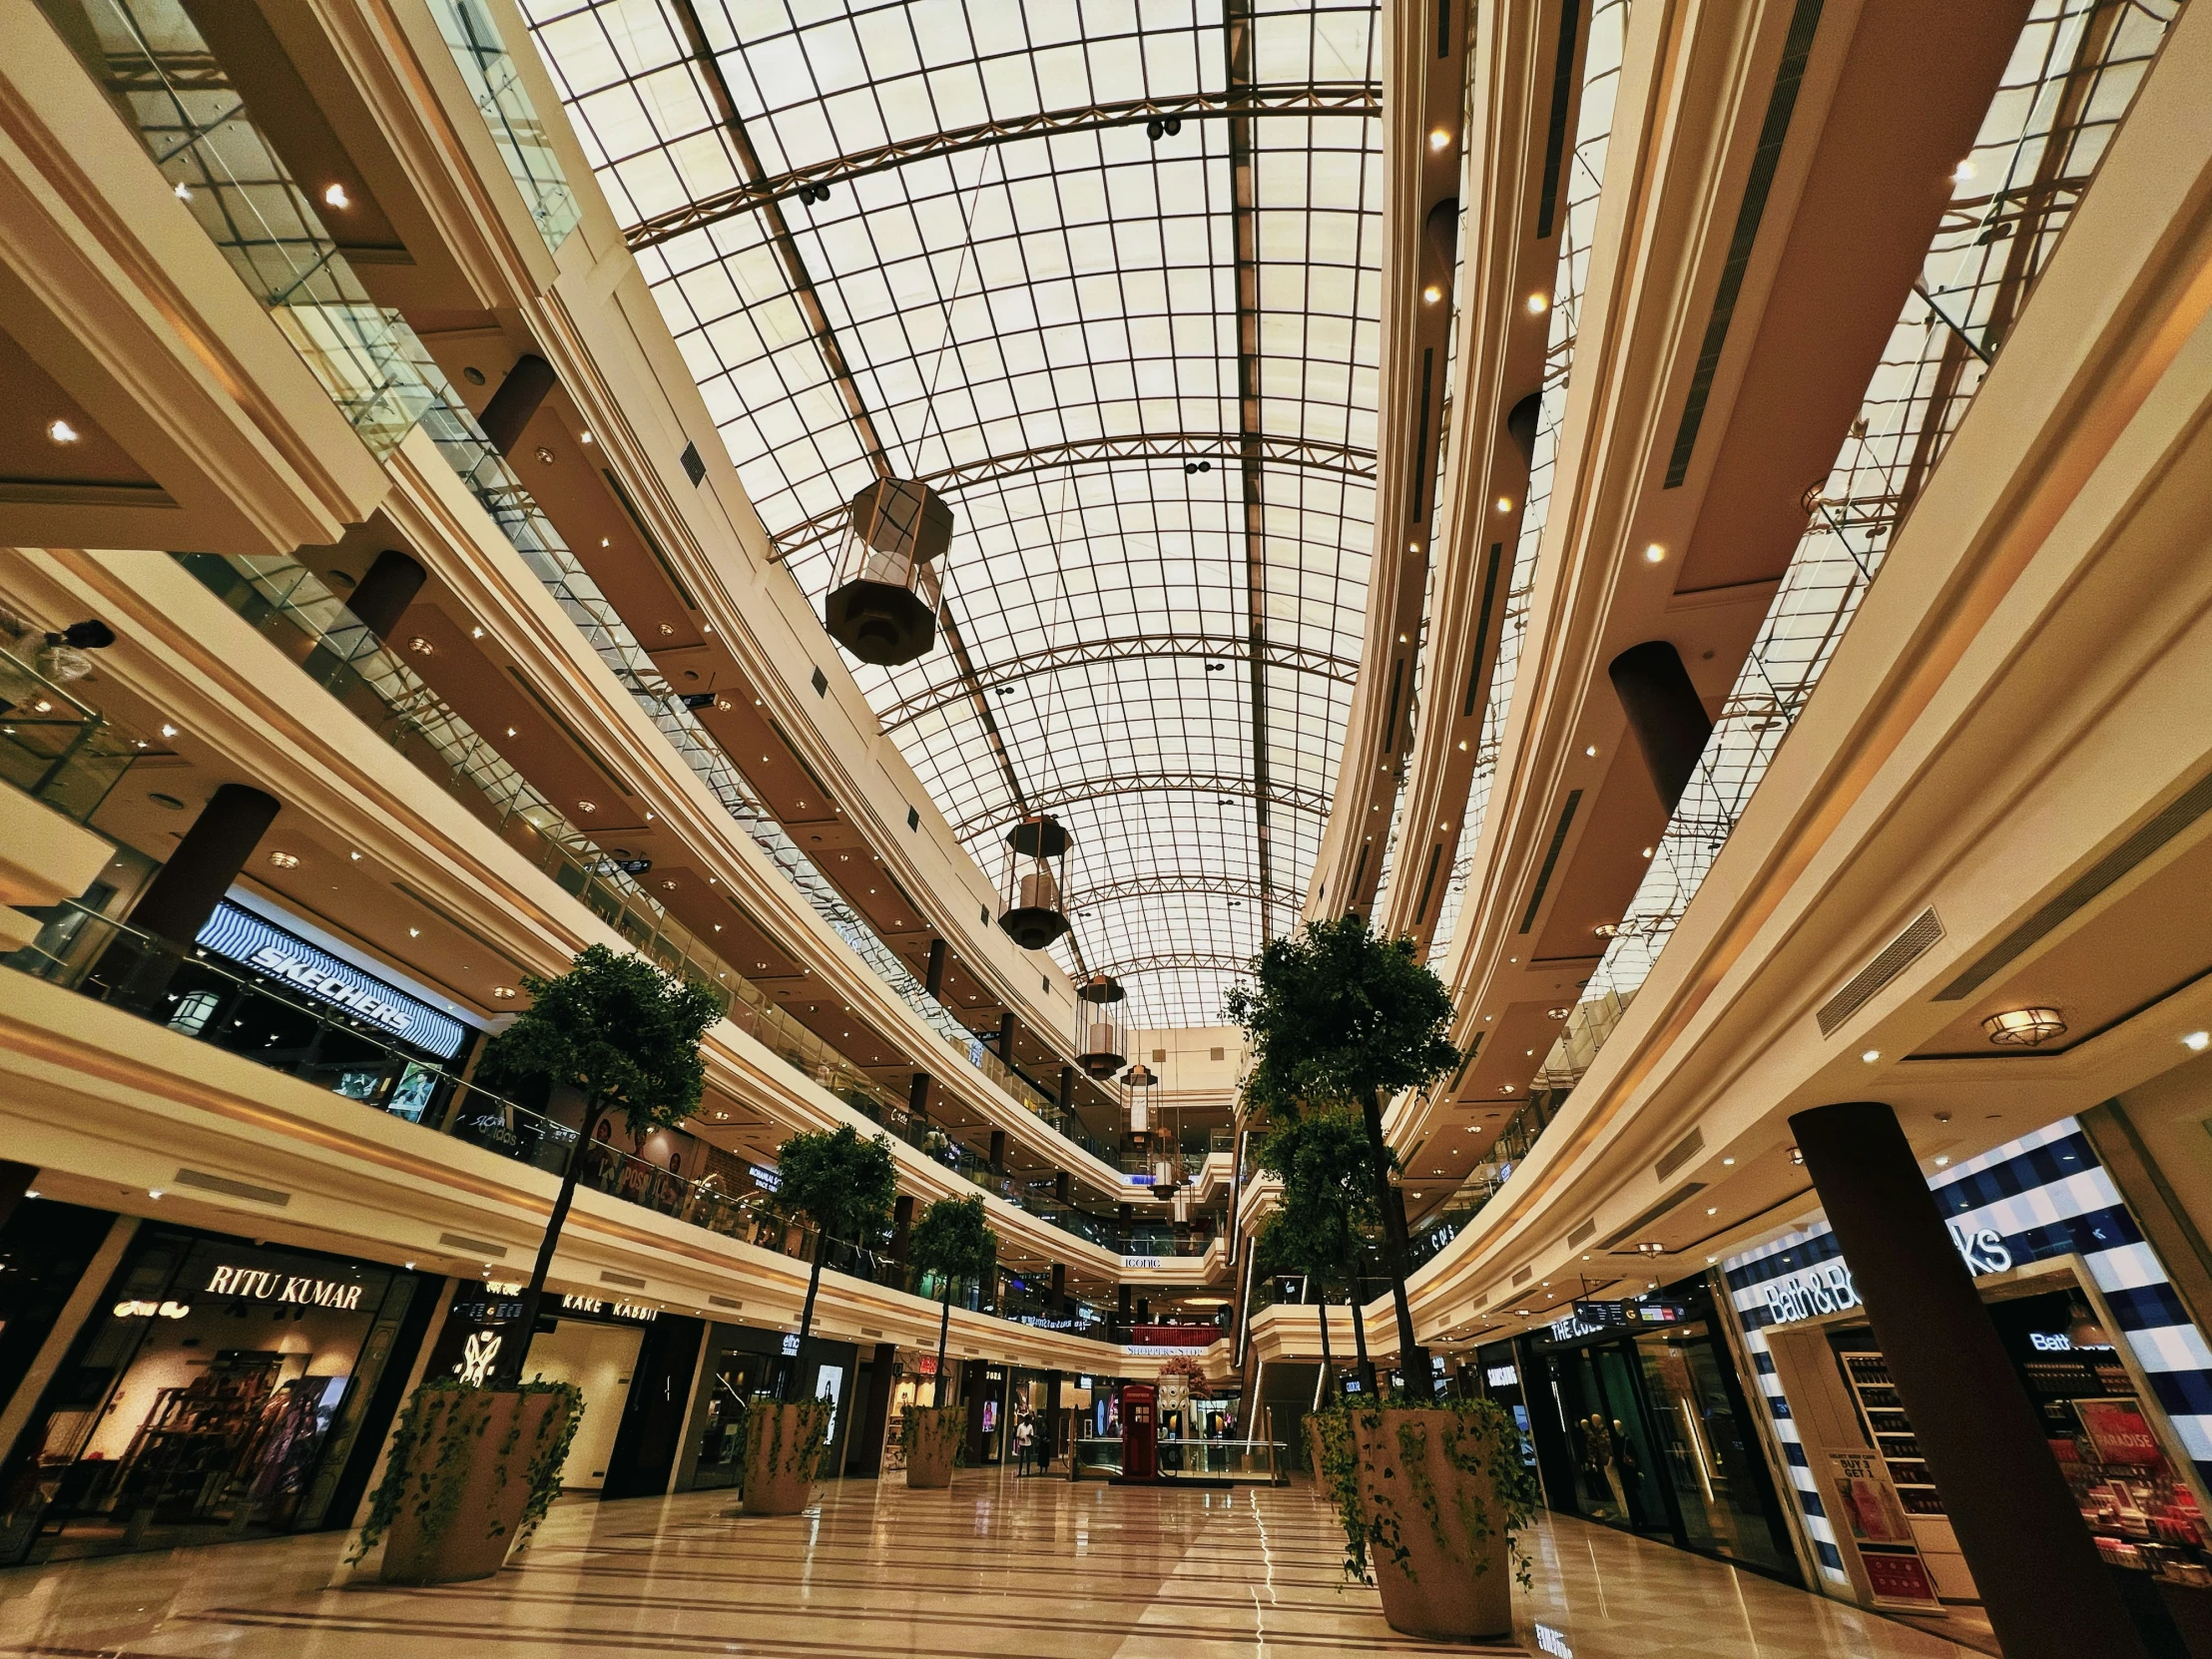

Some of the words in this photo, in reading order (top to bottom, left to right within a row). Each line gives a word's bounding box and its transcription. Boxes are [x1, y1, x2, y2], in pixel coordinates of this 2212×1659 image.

[251, 945, 415, 1031] SKECHERS
[478, 1124, 517, 1146] aidas
[206, 1265, 281, 1300] RITU
[277, 1276, 362, 1311] KUMAR
[1763, 1278, 1819, 1325] Bath
[1825, 1264, 1864, 1311] Bo
[1550, 1320, 1572, 1343] THE
[1127, 1346, 1175, 1357] SHOPPERS
[1178, 1346, 1203, 1357] STOP
[2095, 1433, 2154, 1447] PARADISE
[1841, 1459, 1861, 1468] BUY
[1863, 1459, 1871, 1468] 3
[1845, 1468, 1865, 1477] GET
